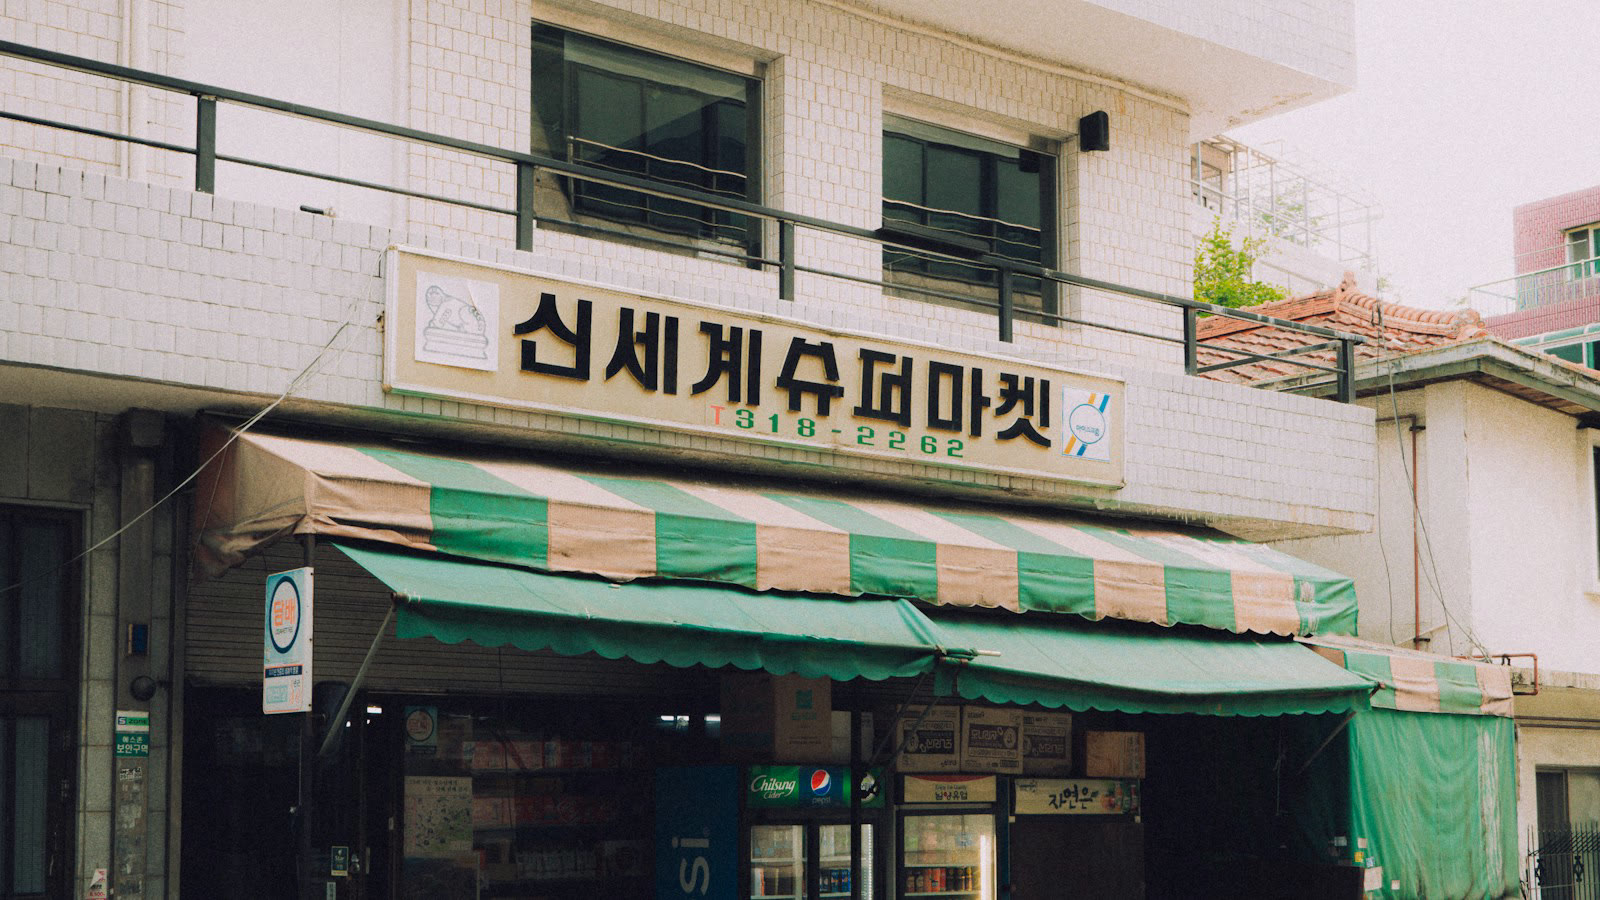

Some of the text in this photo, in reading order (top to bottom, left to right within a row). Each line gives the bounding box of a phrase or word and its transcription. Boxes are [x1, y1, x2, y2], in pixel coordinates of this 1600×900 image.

[512, 292, 1051, 448] 신세계슈퍼마켓
[710, 405, 964, 458] T 318-2262
[274, 598, 296, 626] 담배
[116, 743, 149, 754] 보안구역
[750, 774, 796, 797] Chilsung
[763, 791, 784, 799] Cider
[1048, 784, 1095, 810] 자연은
